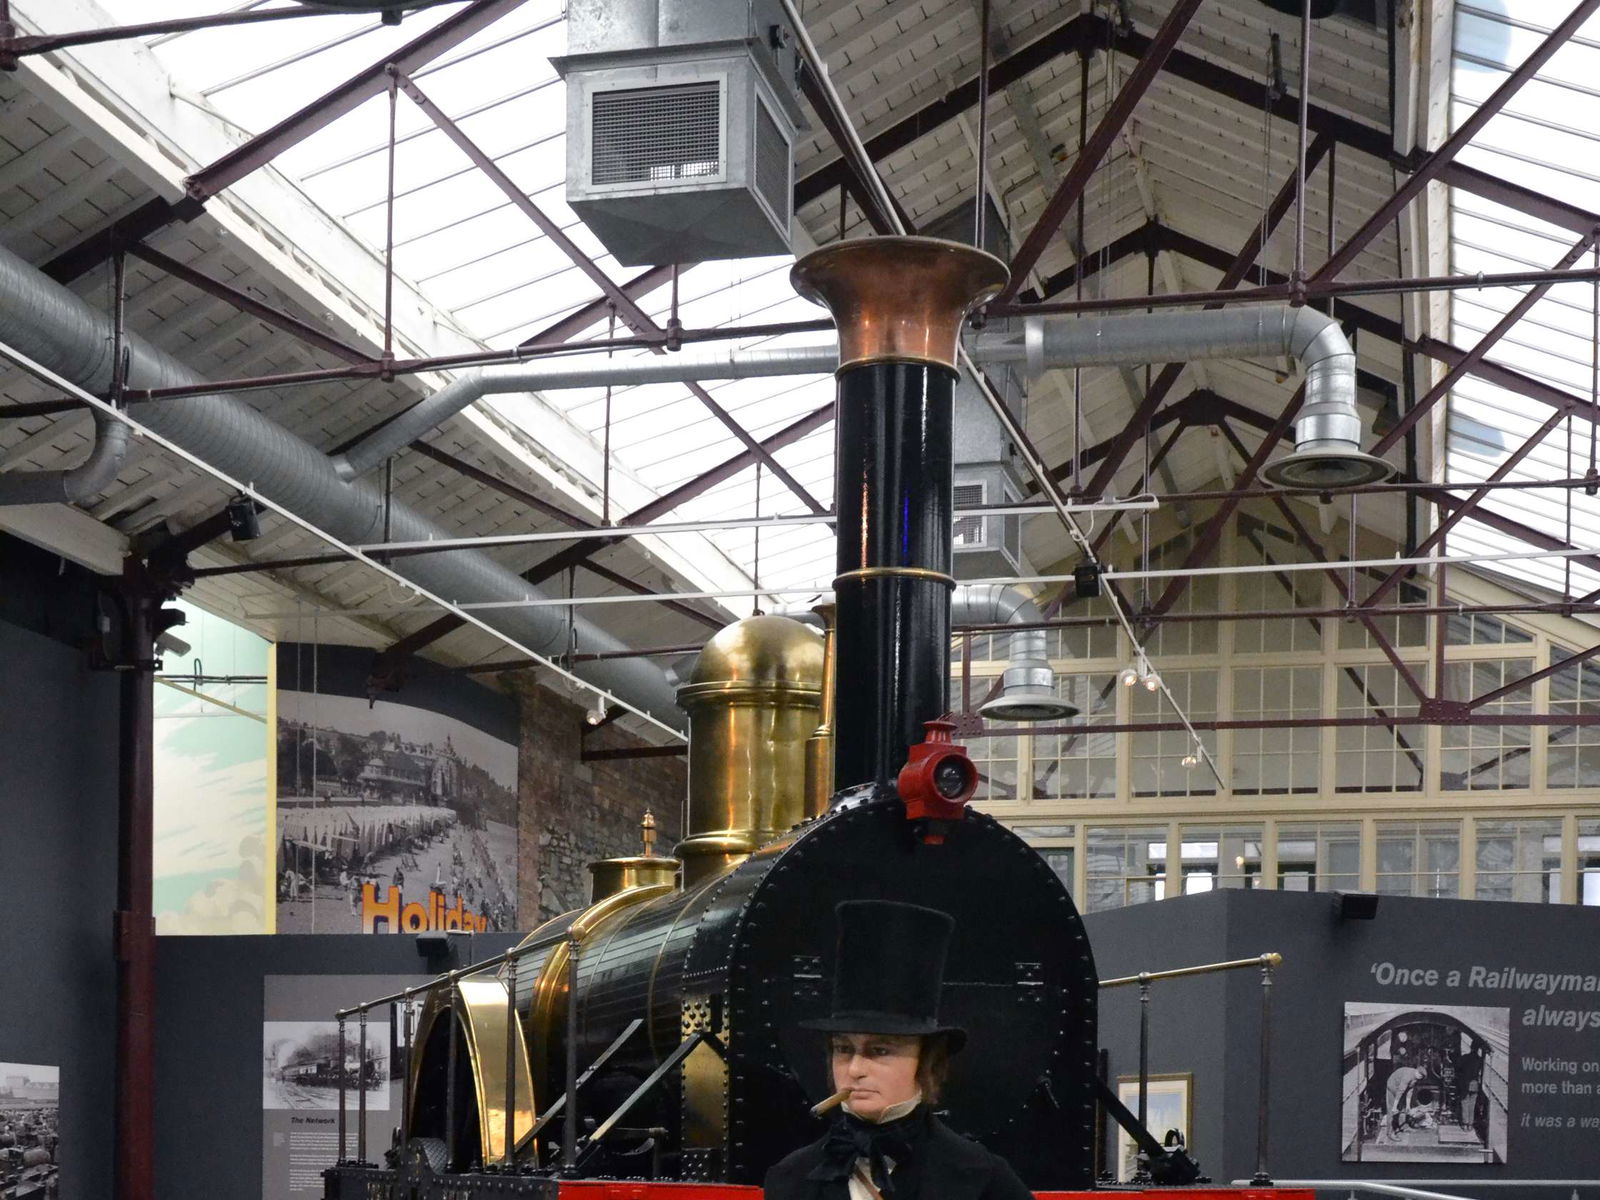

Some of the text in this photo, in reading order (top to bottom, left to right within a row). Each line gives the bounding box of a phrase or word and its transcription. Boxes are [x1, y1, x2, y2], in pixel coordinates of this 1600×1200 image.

[362, 883, 488, 934] Holiday
[1370, 962, 1439, 985] ‘Once
[1446, 970, 1460, 987] a
[1522, 1004, 1600, 1032] always
[1521, 1057, 1599, 1076] Working on
[1521, 1083, 1558, 1095] more
[1562, 1080, 1592, 1095] than
[1520, 1112, 1600, 1131] it was a wa
